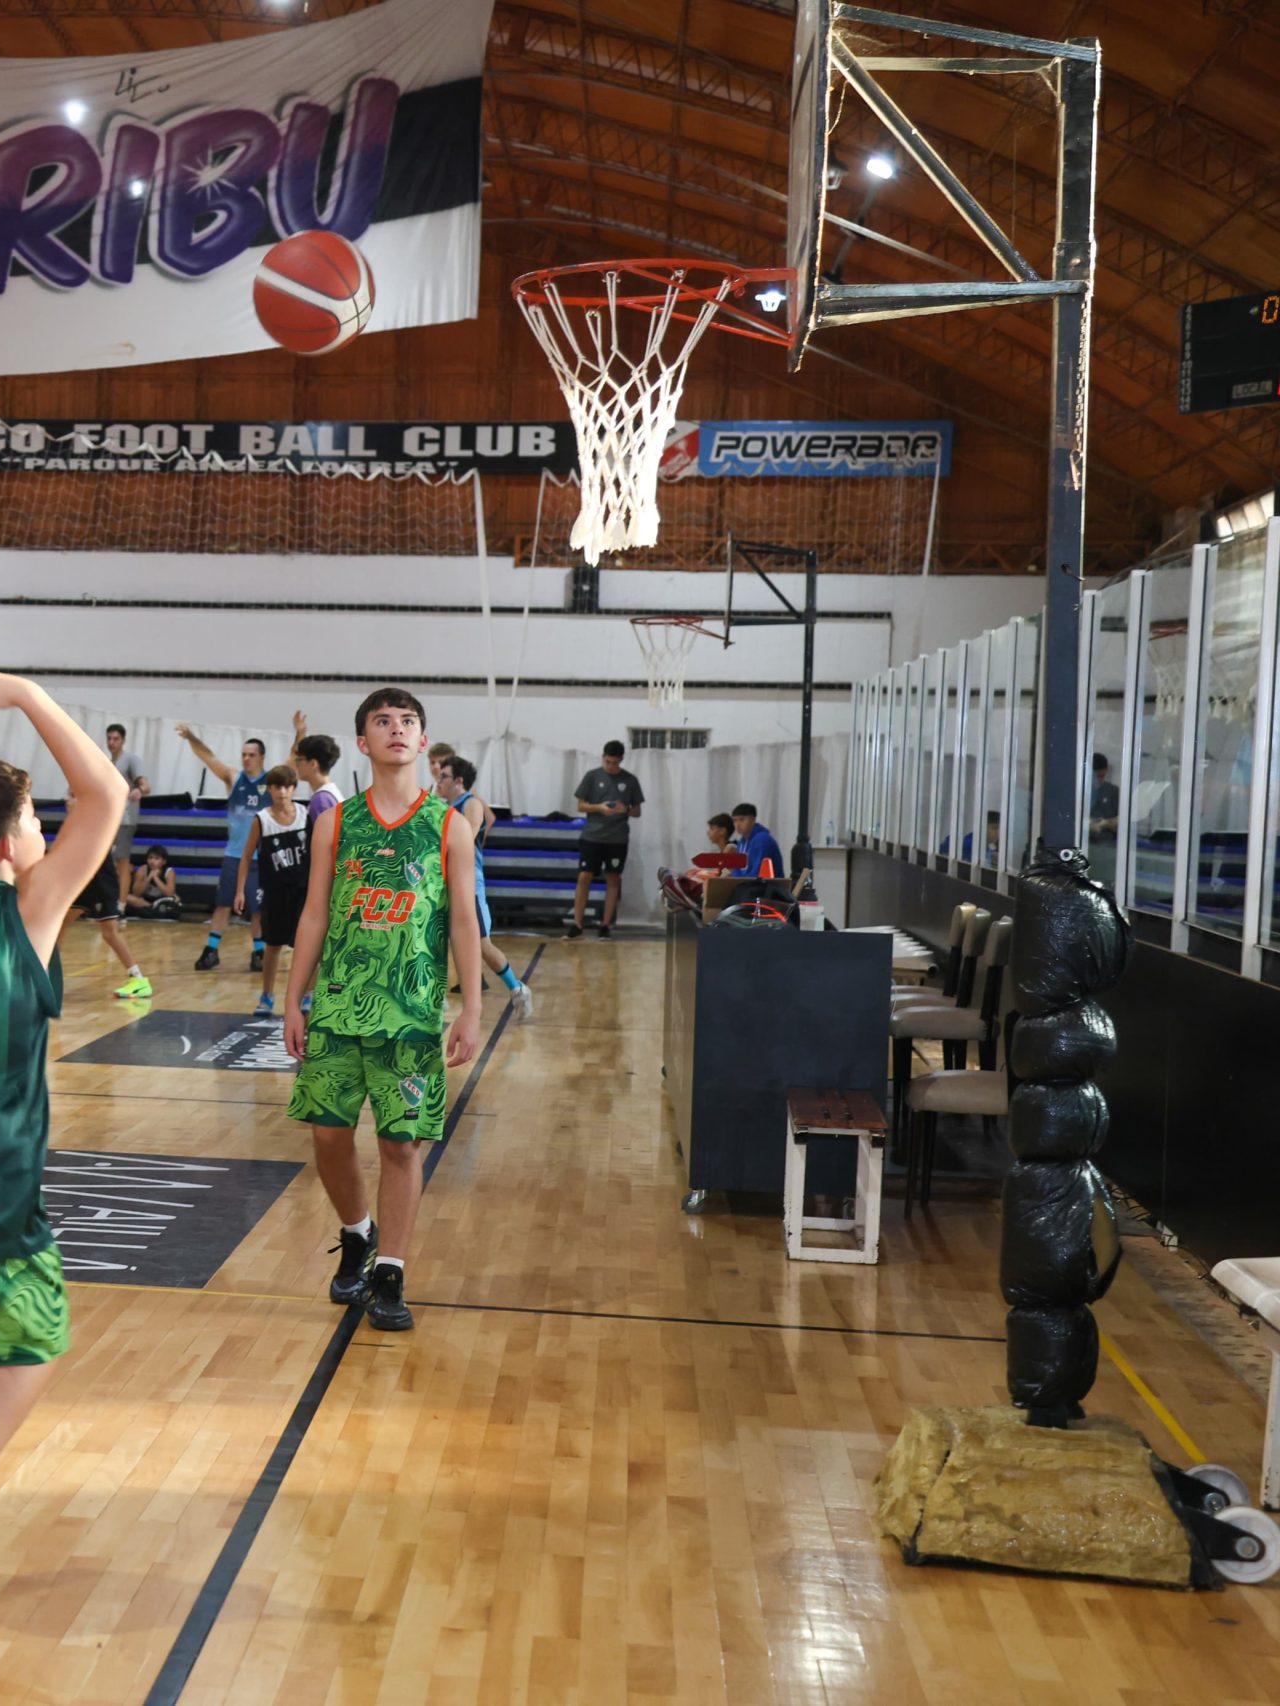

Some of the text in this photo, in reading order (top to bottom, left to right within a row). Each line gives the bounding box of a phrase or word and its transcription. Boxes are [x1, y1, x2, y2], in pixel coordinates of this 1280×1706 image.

[72, 423, 215, 455] FOOT
[239, 425, 378, 457] BALL
[403, 425, 557, 458] CLUB
[343, 859, 363, 880] 24
[346, 887, 417, 924] FCO
